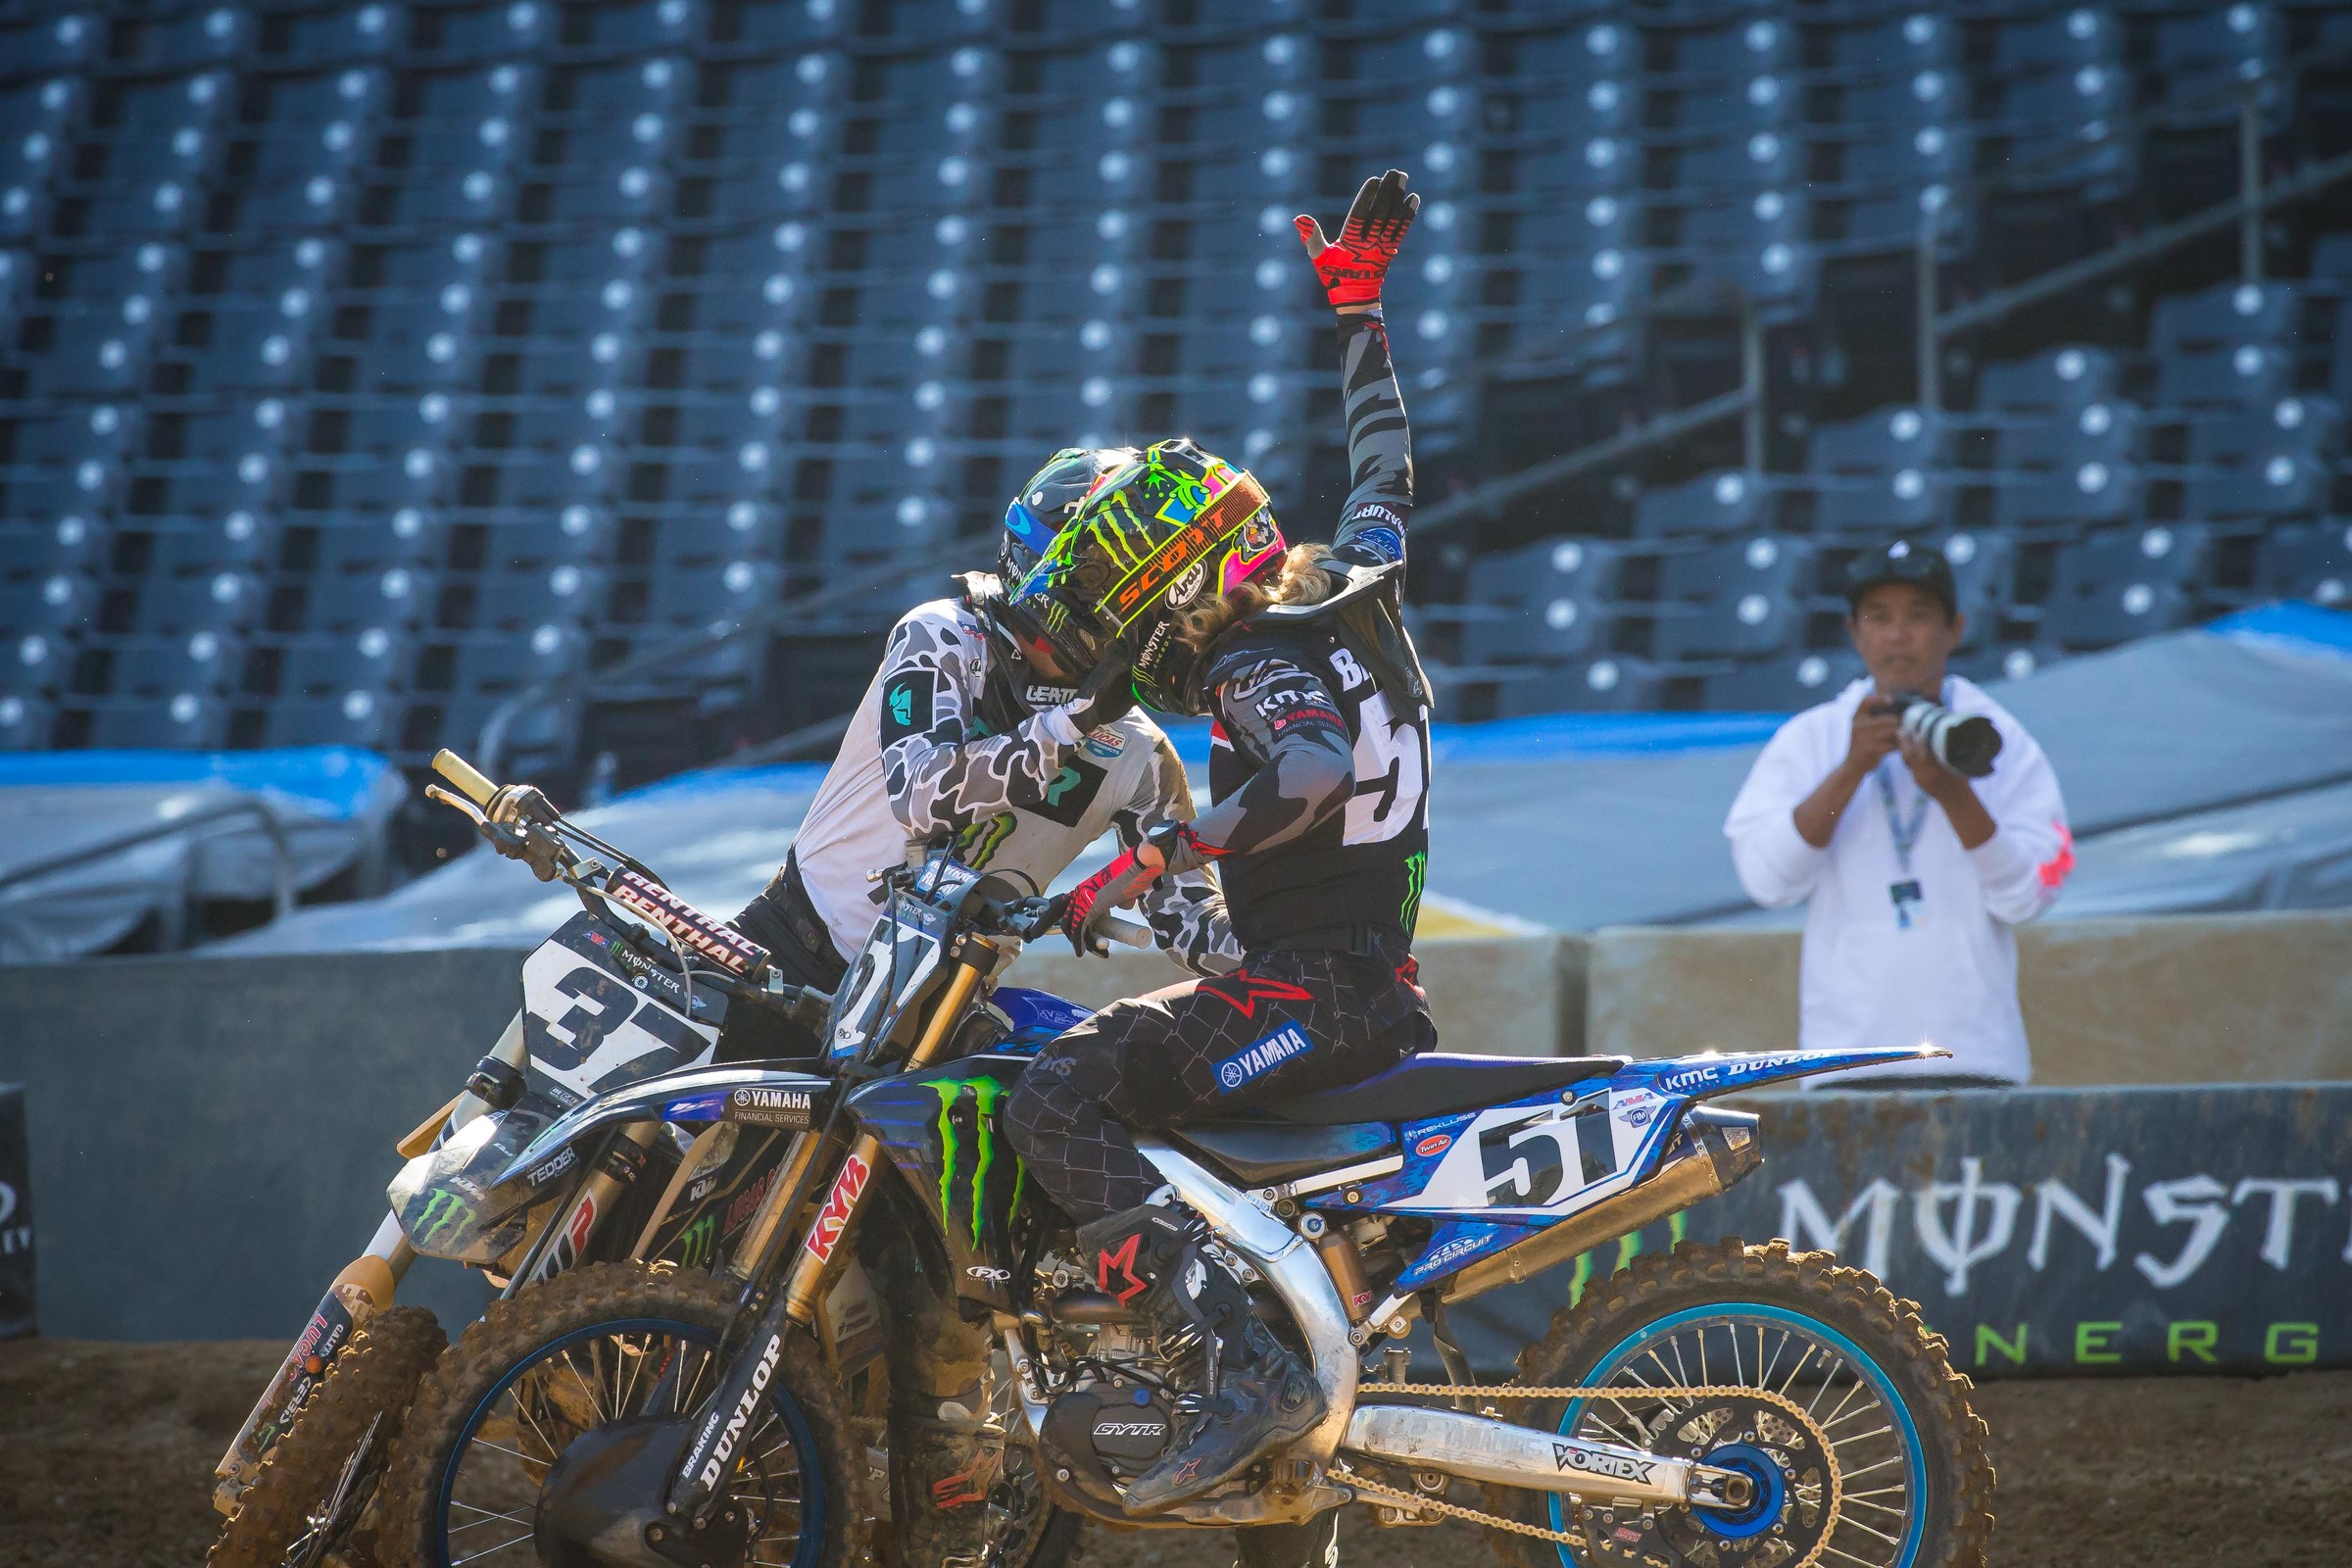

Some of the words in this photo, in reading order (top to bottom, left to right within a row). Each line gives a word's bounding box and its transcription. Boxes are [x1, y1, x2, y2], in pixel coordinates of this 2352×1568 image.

[1138, 620, 1170, 669] MONSTER
[612, 884, 747, 974] RENTHAL
[622, 870, 757, 956] RENTHAL
[621, 949, 680, 994] MONSTER
[752, 1091, 811, 1109] YAMAHA
[1665, 1067, 1718, 1091] KMC
[735, 1111, 772, 1122] FINANCIAL
[775, 1114, 809, 1124] SERVICES
[1611, 1093, 1656, 1110] AMA
[1632, 1111, 1647, 1122] FIM
[1417, 1112, 1477, 1136] REKLUSE
[1420, 1142, 1438, 1153] Twin
[1438, 1137, 1450, 1148] Air
[1478, 1090, 1618, 1206] 51
[804, 1153, 871, 1265] KYB
[1414, 1258, 1442, 1276] PRO
[1445, 1233, 1494, 1262] CIRCUIT
[1972, 1323, 2321, 1365] NERG
[700, 1334, 781, 1492] DUNLOP
[1093, 1422, 1166, 1436] GYTR
[682, 1412, 720, 1479] BRAKING
[1551, 1442, 1658, 1485] VORTEX
